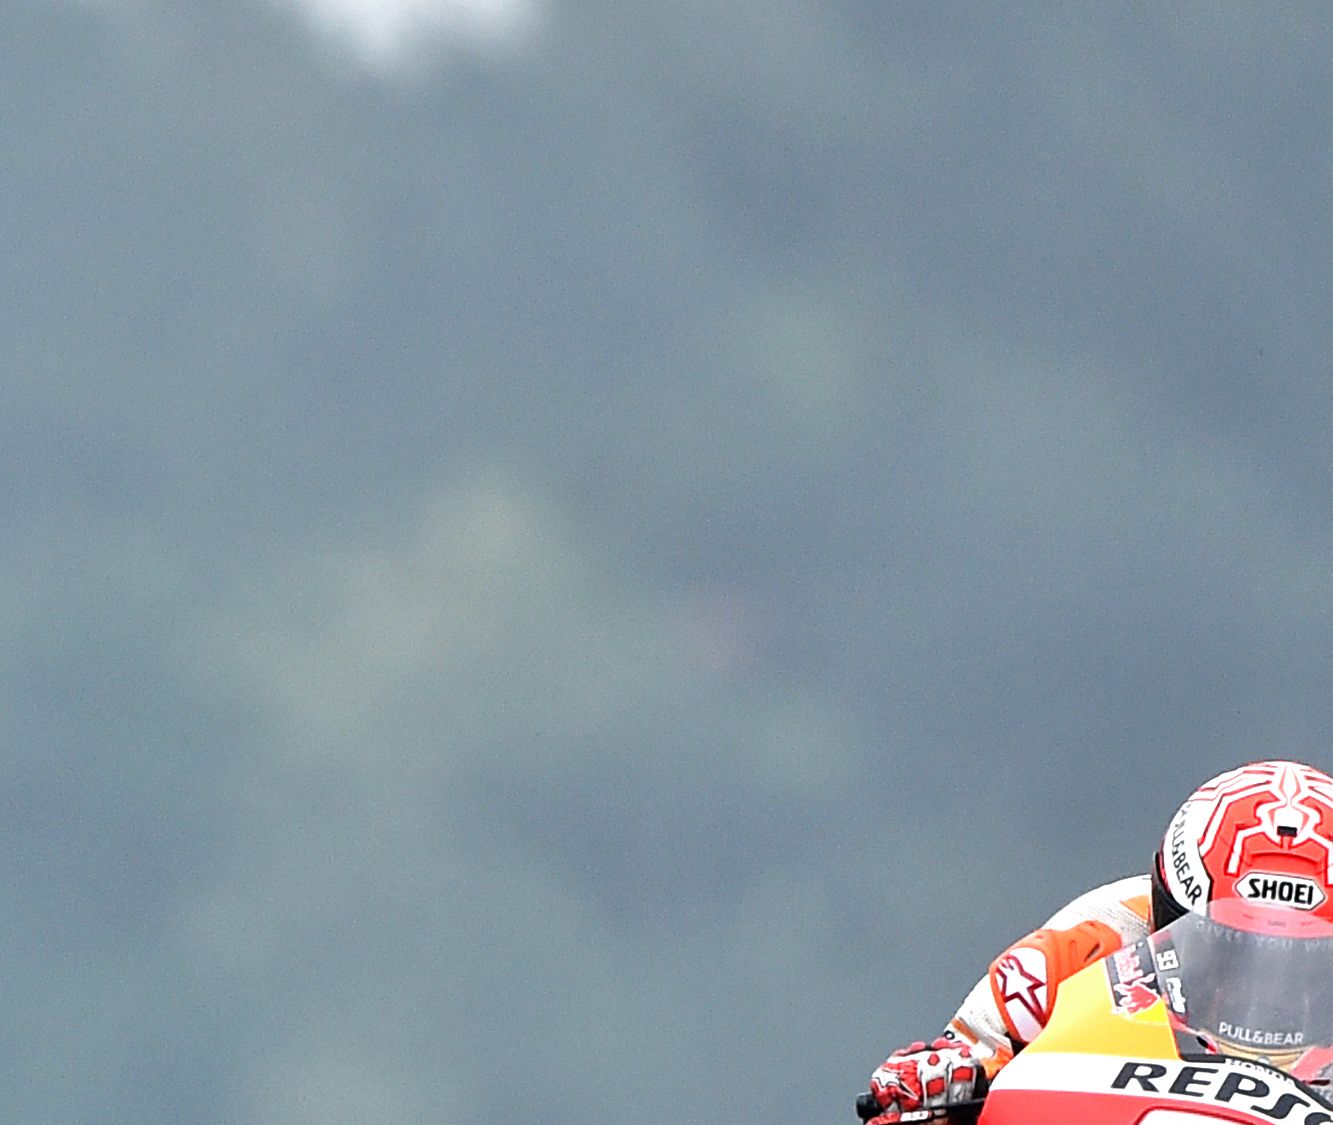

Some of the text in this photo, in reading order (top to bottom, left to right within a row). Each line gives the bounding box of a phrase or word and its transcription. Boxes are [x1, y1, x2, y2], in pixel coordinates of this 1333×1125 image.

[1171, 803, 1203, 906] LL&BEAR
[1248, 877, 1314, 906] SHOEI
[1218, 1021, 1304, 1046] PULL&BEAR
